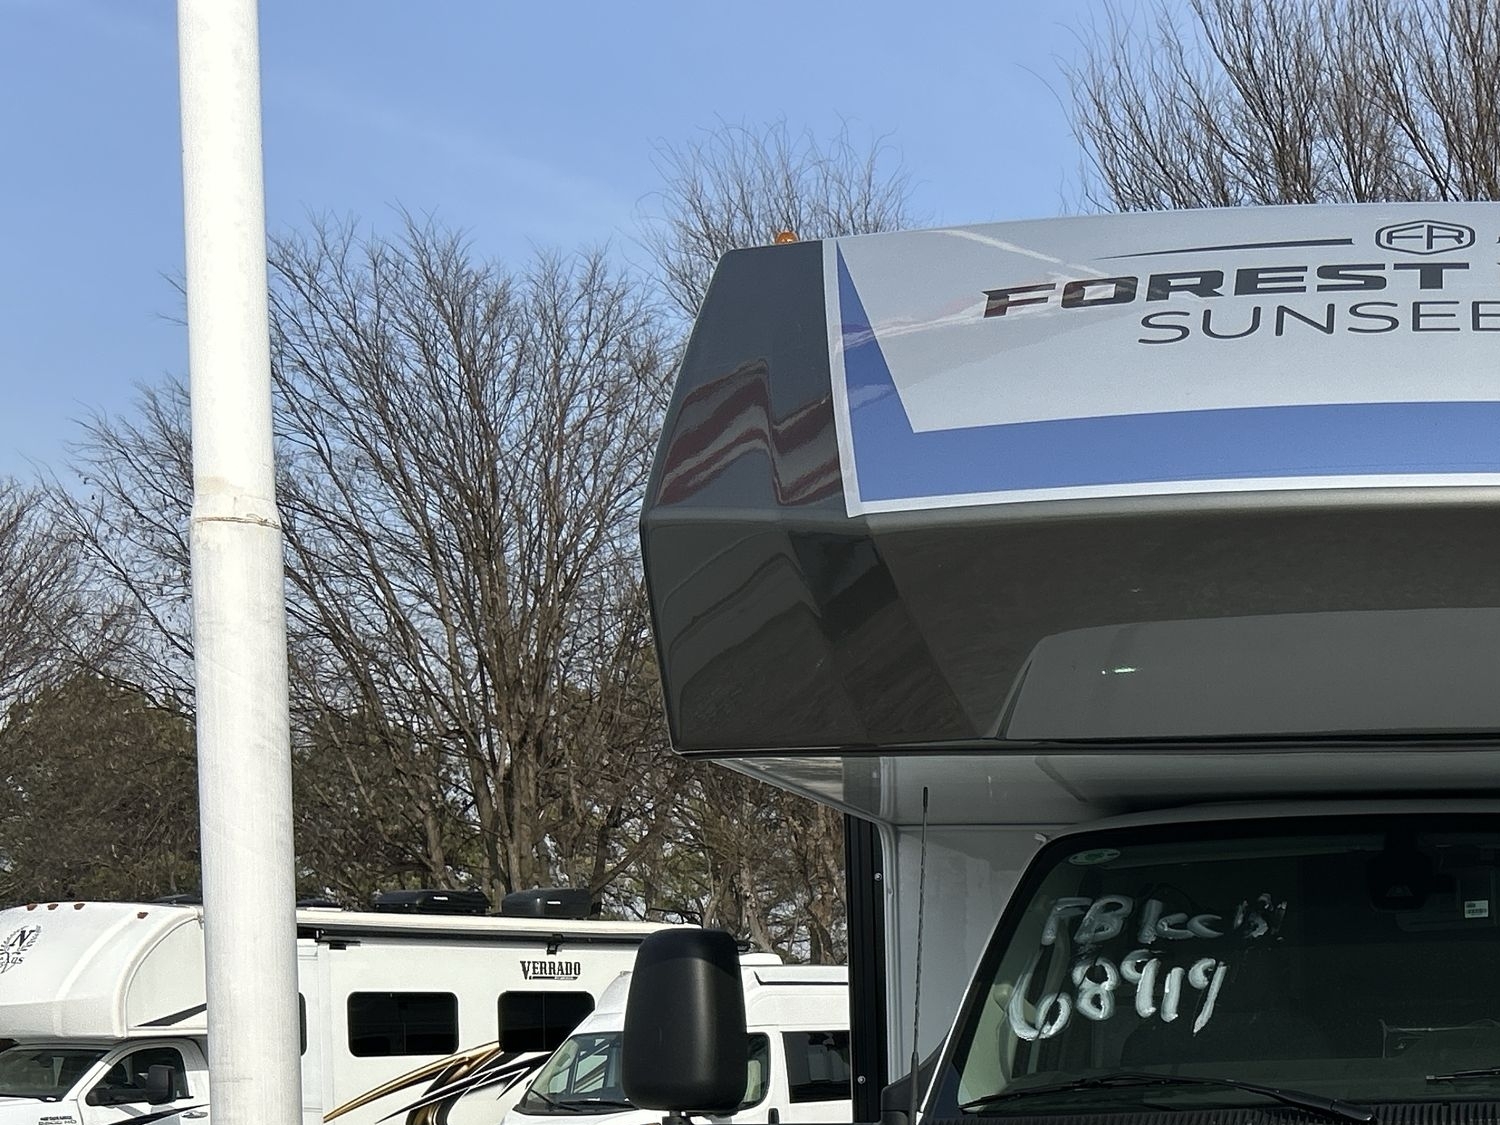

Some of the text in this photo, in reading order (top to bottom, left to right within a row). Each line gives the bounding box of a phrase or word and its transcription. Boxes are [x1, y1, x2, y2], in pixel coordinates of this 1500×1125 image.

[982, 262, 1471, 319] FOREST
[519, 960, 582, 981] VERRADO
[1007, 949, 1229, 1042] 68919
